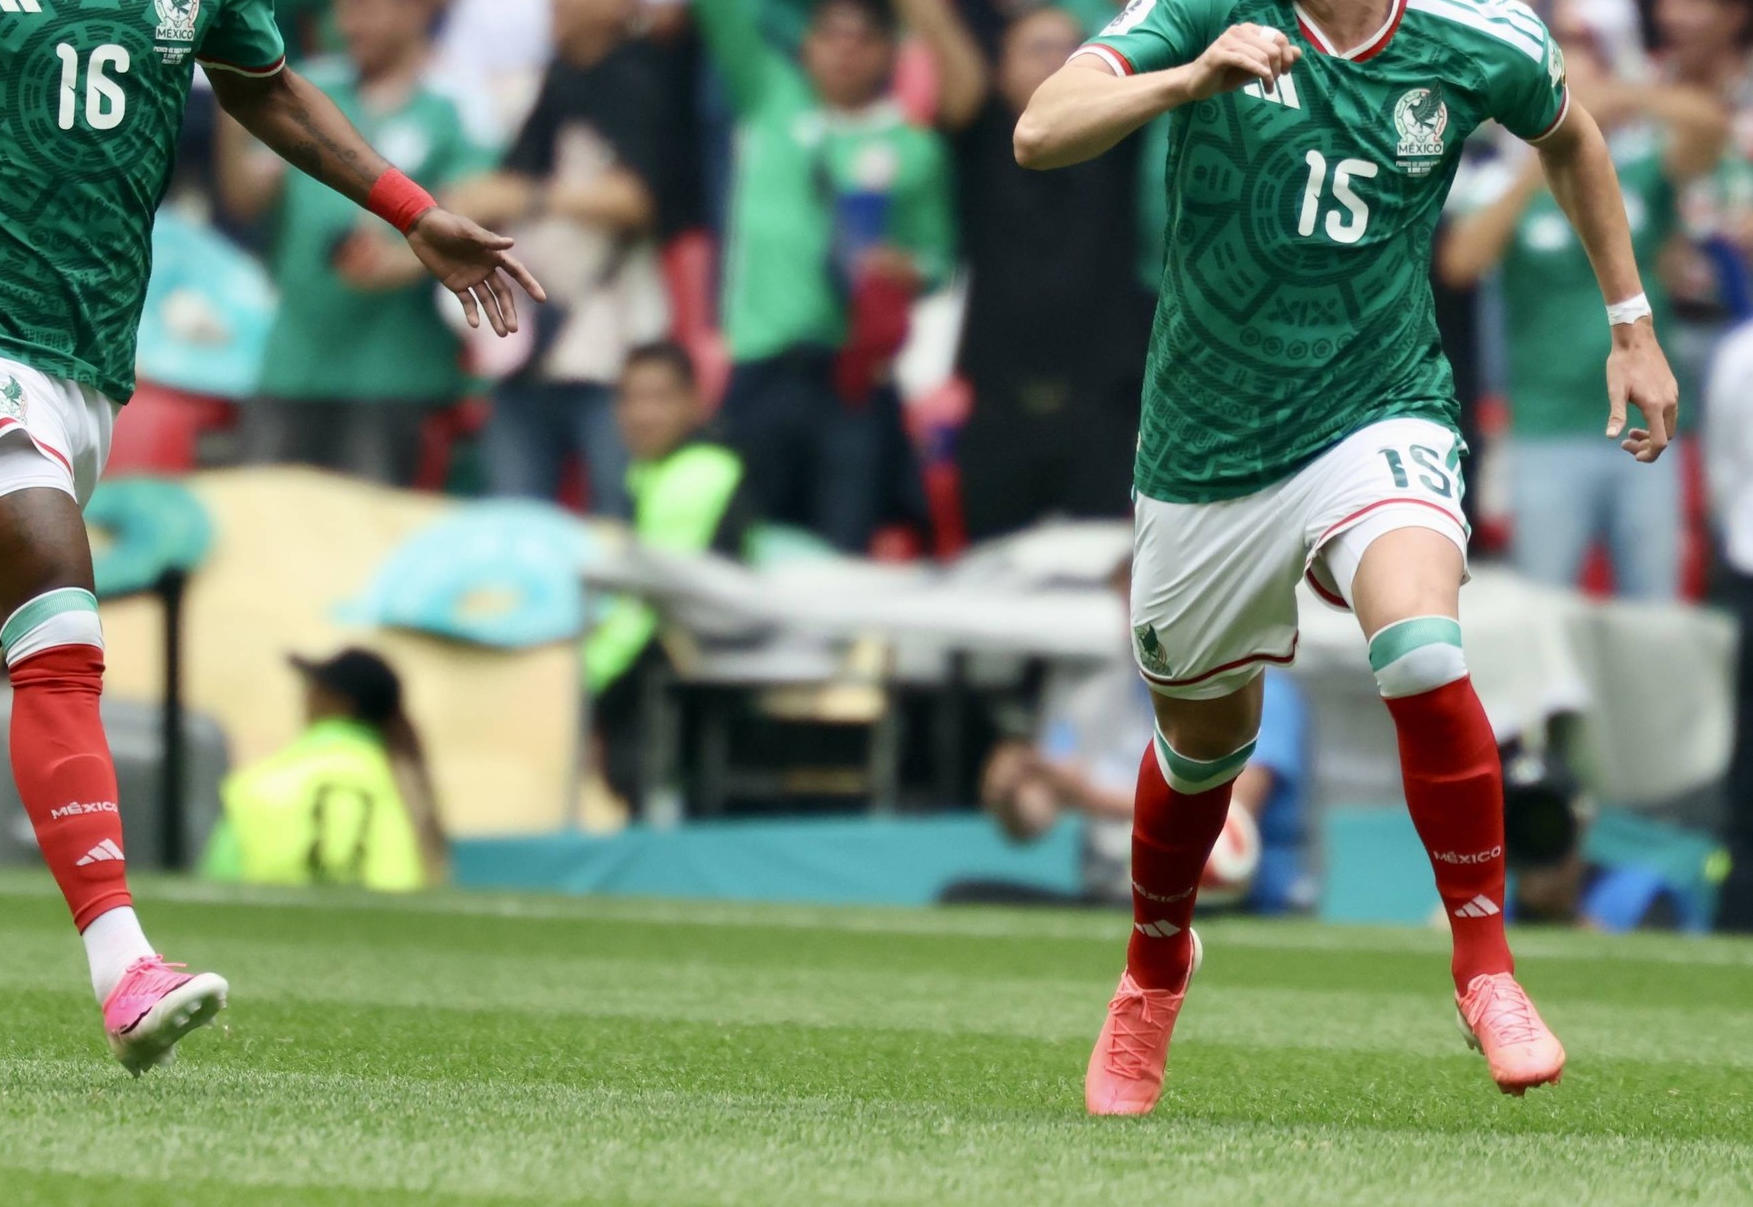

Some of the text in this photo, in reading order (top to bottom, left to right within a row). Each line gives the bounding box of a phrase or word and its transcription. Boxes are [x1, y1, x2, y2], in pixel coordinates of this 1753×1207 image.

[157, 27, 194, 40] MÉXICO
[56, 42, 130, 130] 16
[1398, 141, 1443, 154] MÉXICO
[1298, 149, 1379, 244] 15
[1377, 444, 1453, 499] 15
